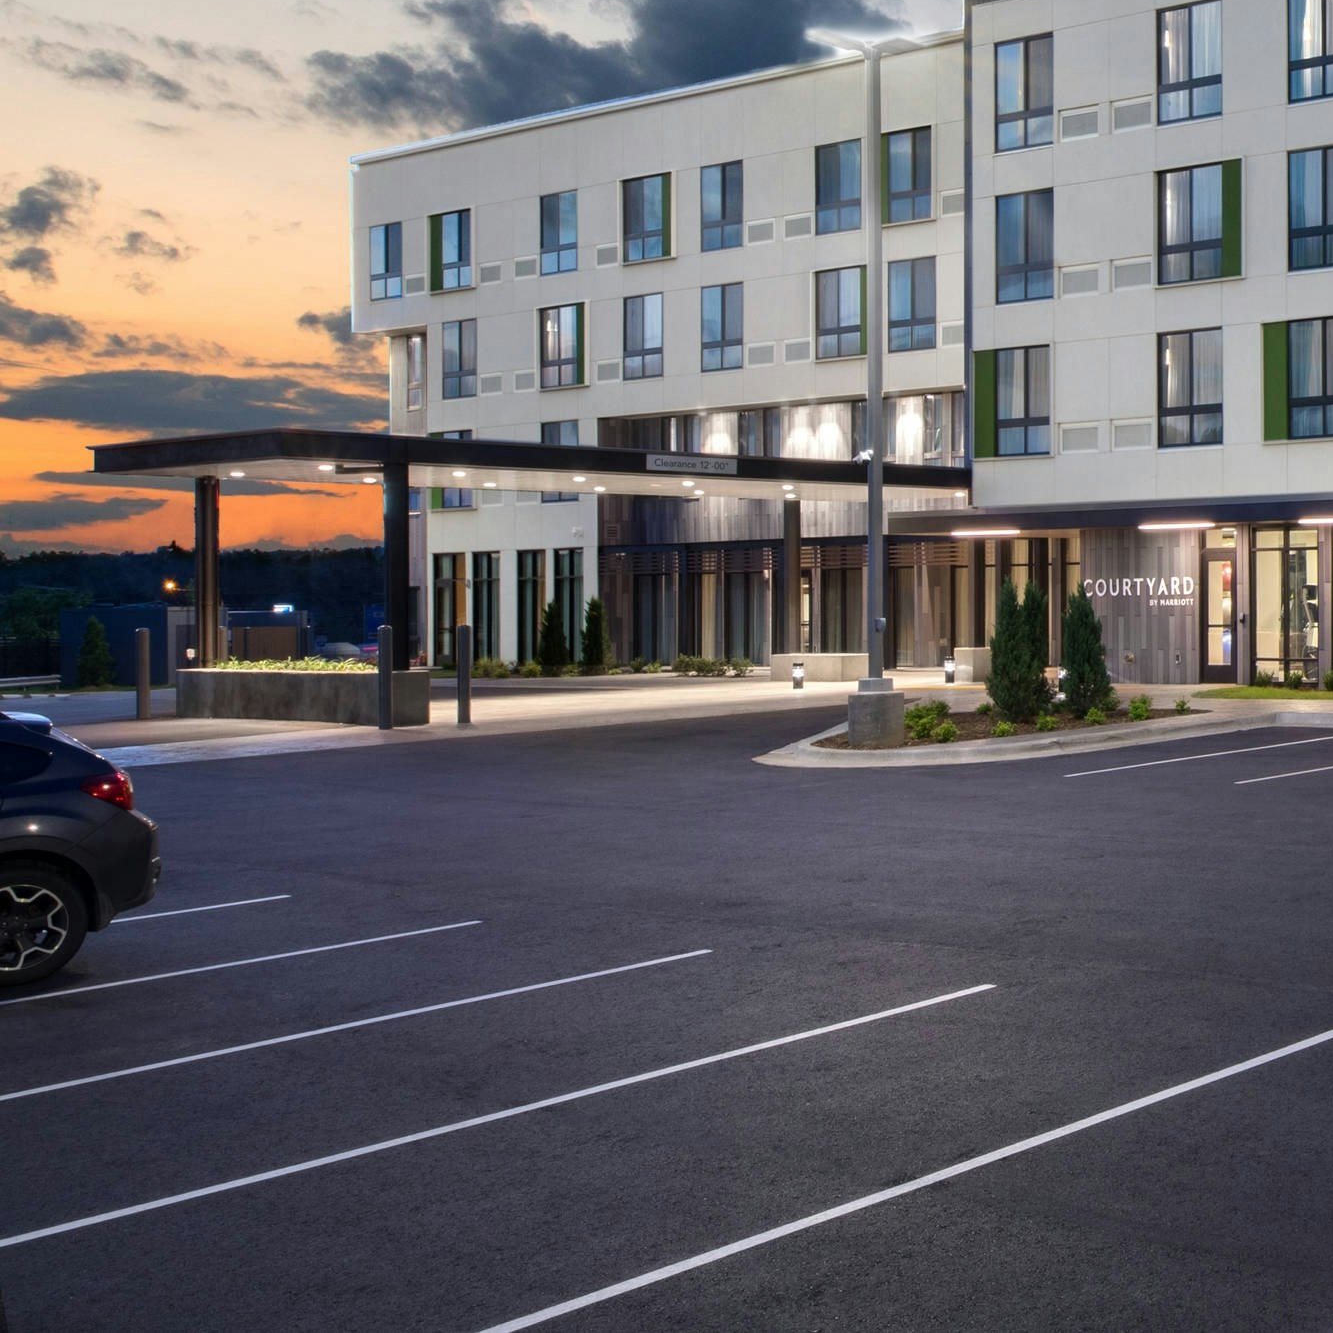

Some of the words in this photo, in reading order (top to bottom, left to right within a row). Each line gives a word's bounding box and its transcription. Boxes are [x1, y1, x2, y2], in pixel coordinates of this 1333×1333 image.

[654, 457, 697, 468] Clearance
[1084, 576, 1194, 597] COURTYARD
[1149, 599, 1158, 607] BY
[1160, 598, 1194, 607] MARRIOTT
